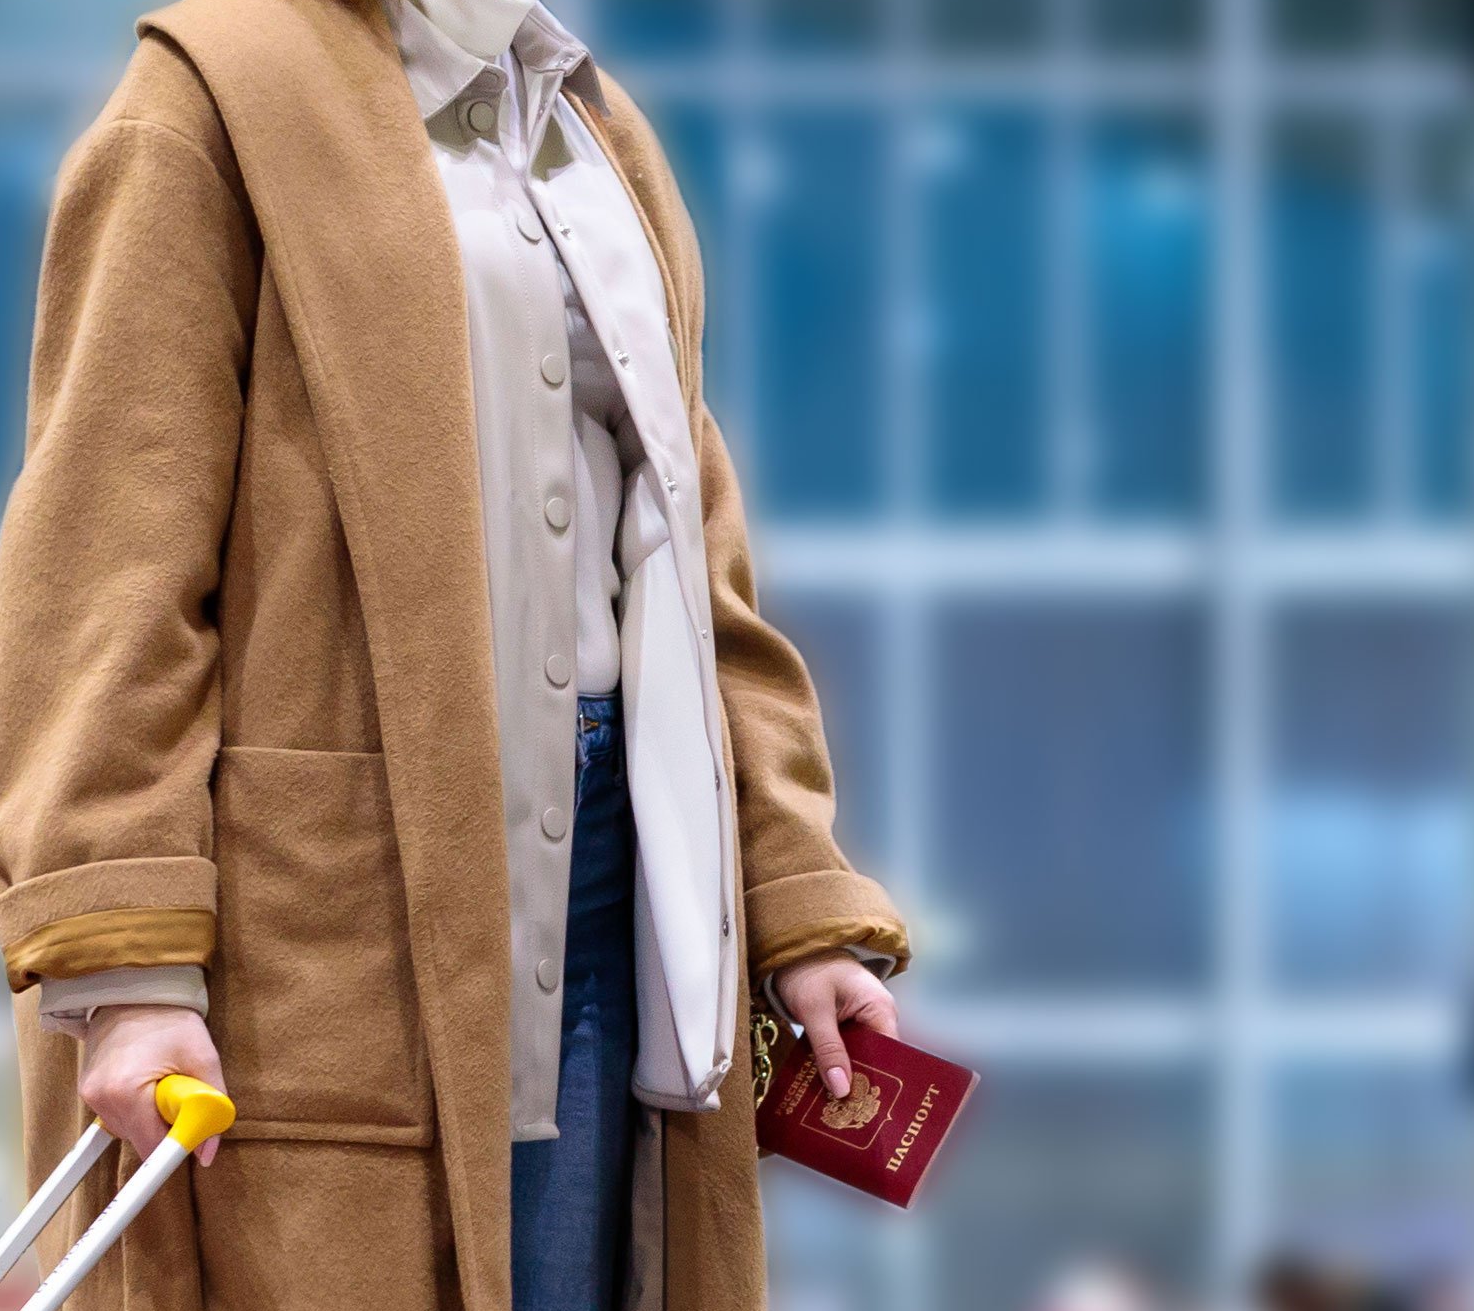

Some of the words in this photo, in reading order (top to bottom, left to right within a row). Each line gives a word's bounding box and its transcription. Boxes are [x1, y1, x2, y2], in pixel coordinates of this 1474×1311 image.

[774, 1053, 815, 1116] РОССИЙСК
[785, 1066, 818, 1115] ФЕДЕРАЦ
[885, 1083, 940, 1172] ПАСПОРТ
